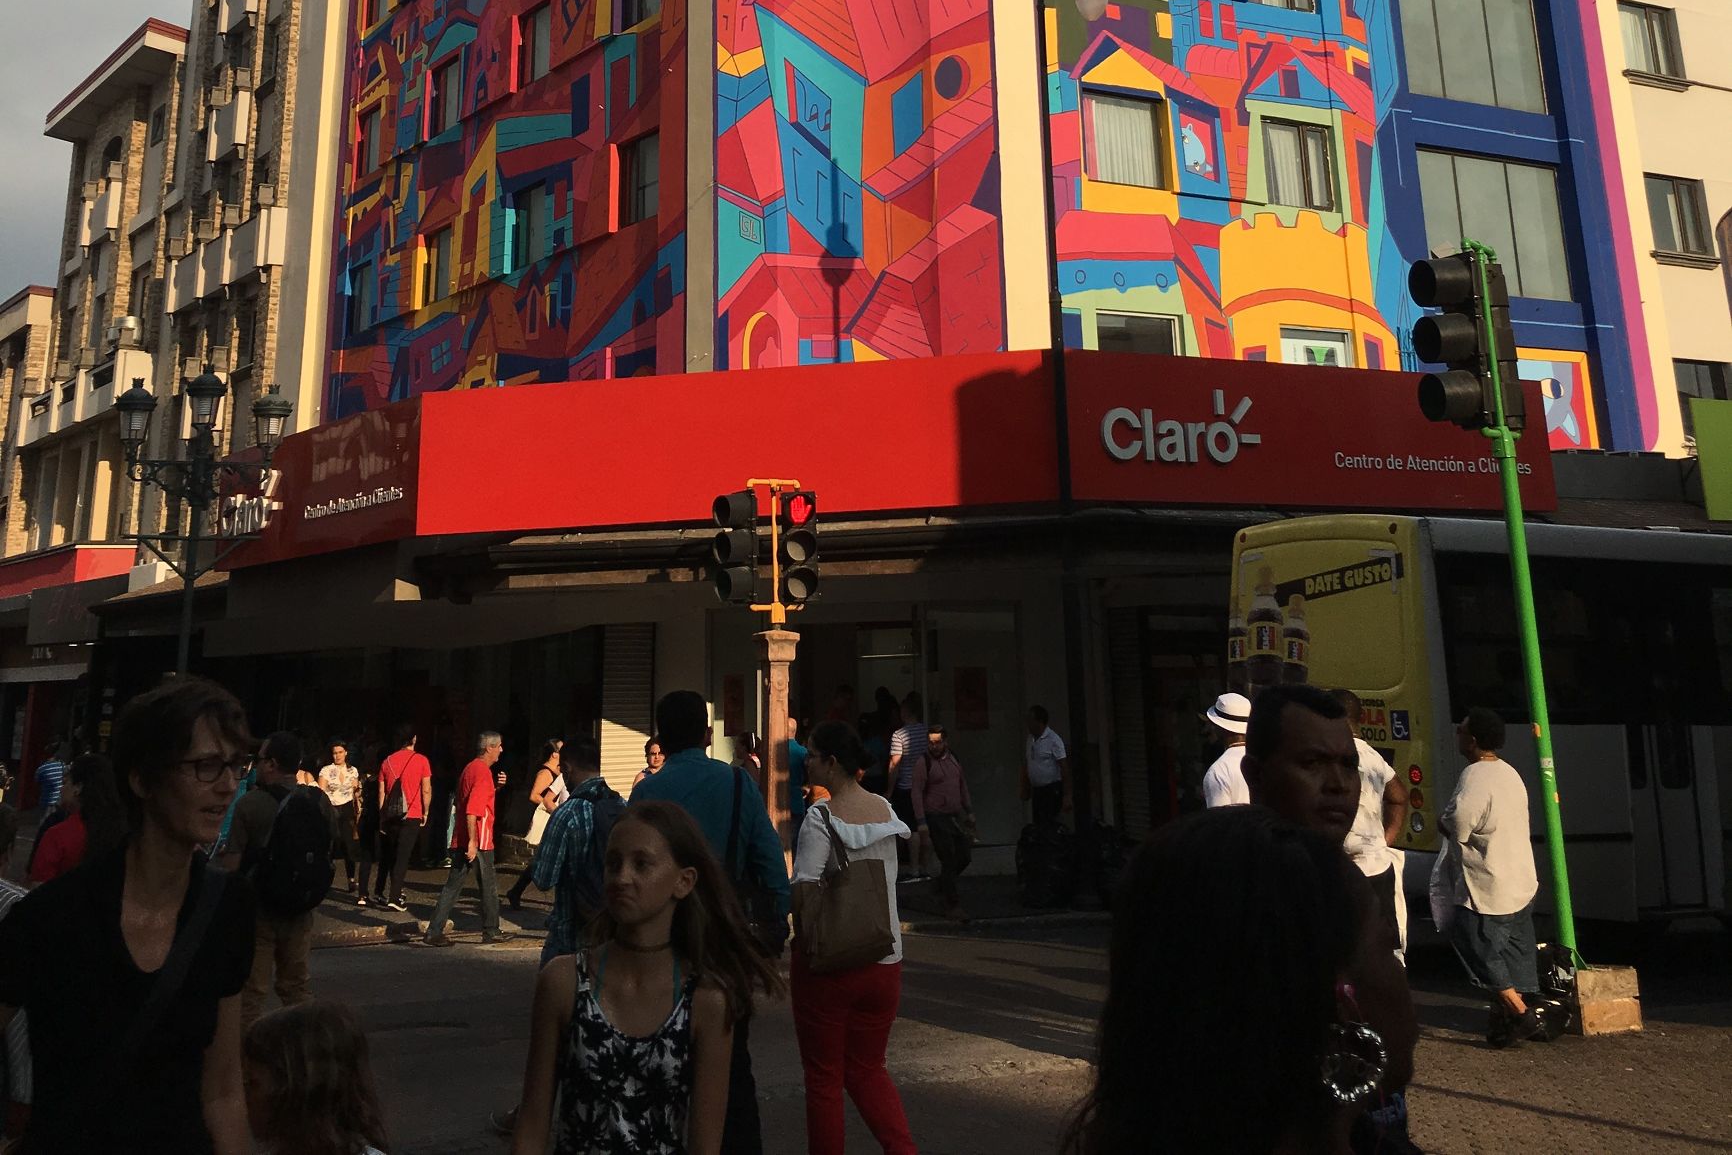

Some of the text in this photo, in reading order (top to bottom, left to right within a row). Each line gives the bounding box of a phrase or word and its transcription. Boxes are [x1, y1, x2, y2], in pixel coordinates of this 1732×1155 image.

[1101, 406, 1240, 464] Claro
[1334, 451, 1532, 475] Centro de Atención a Clies
[1304, 562, 1392, 596] DATE GUSTO
[1360, 727, 1387, 742] SOLO
